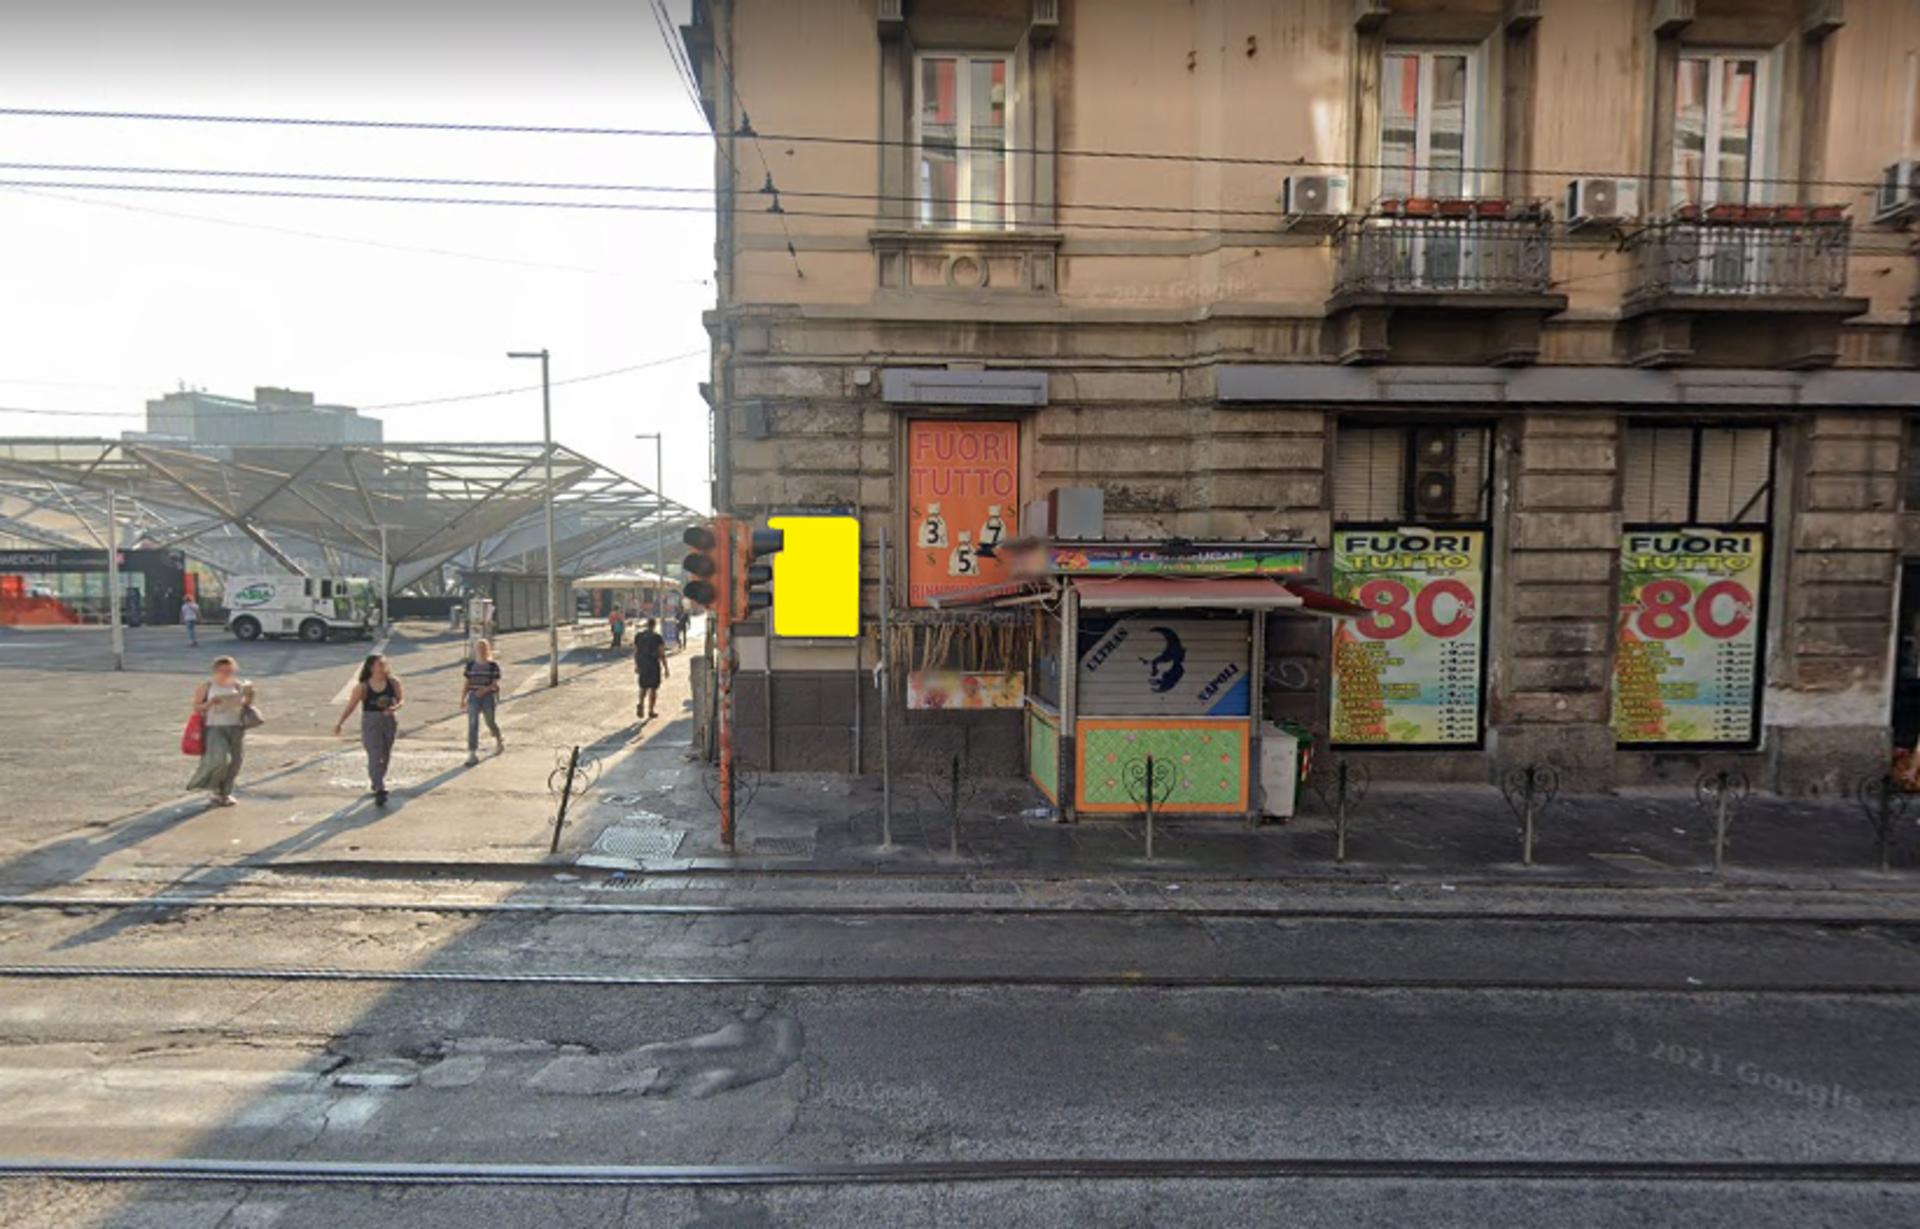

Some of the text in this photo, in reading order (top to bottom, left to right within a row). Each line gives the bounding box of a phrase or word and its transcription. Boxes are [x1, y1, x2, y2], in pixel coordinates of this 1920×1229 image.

[916, 431, 1009, 461] FUORI
[911, 466, 1014, 496] TUTTO
[1345, 536, 1471, 552] FUORI
[1630, 537, 1752, 553] FUORI
[1351, 553, 1471, 570] TUTTO
[1635, 555, 1752, 571] TUTTO
[1085, 626, 1129, 672] ULTRAS
[1198, 663, 1240, 700] NAPOLI
